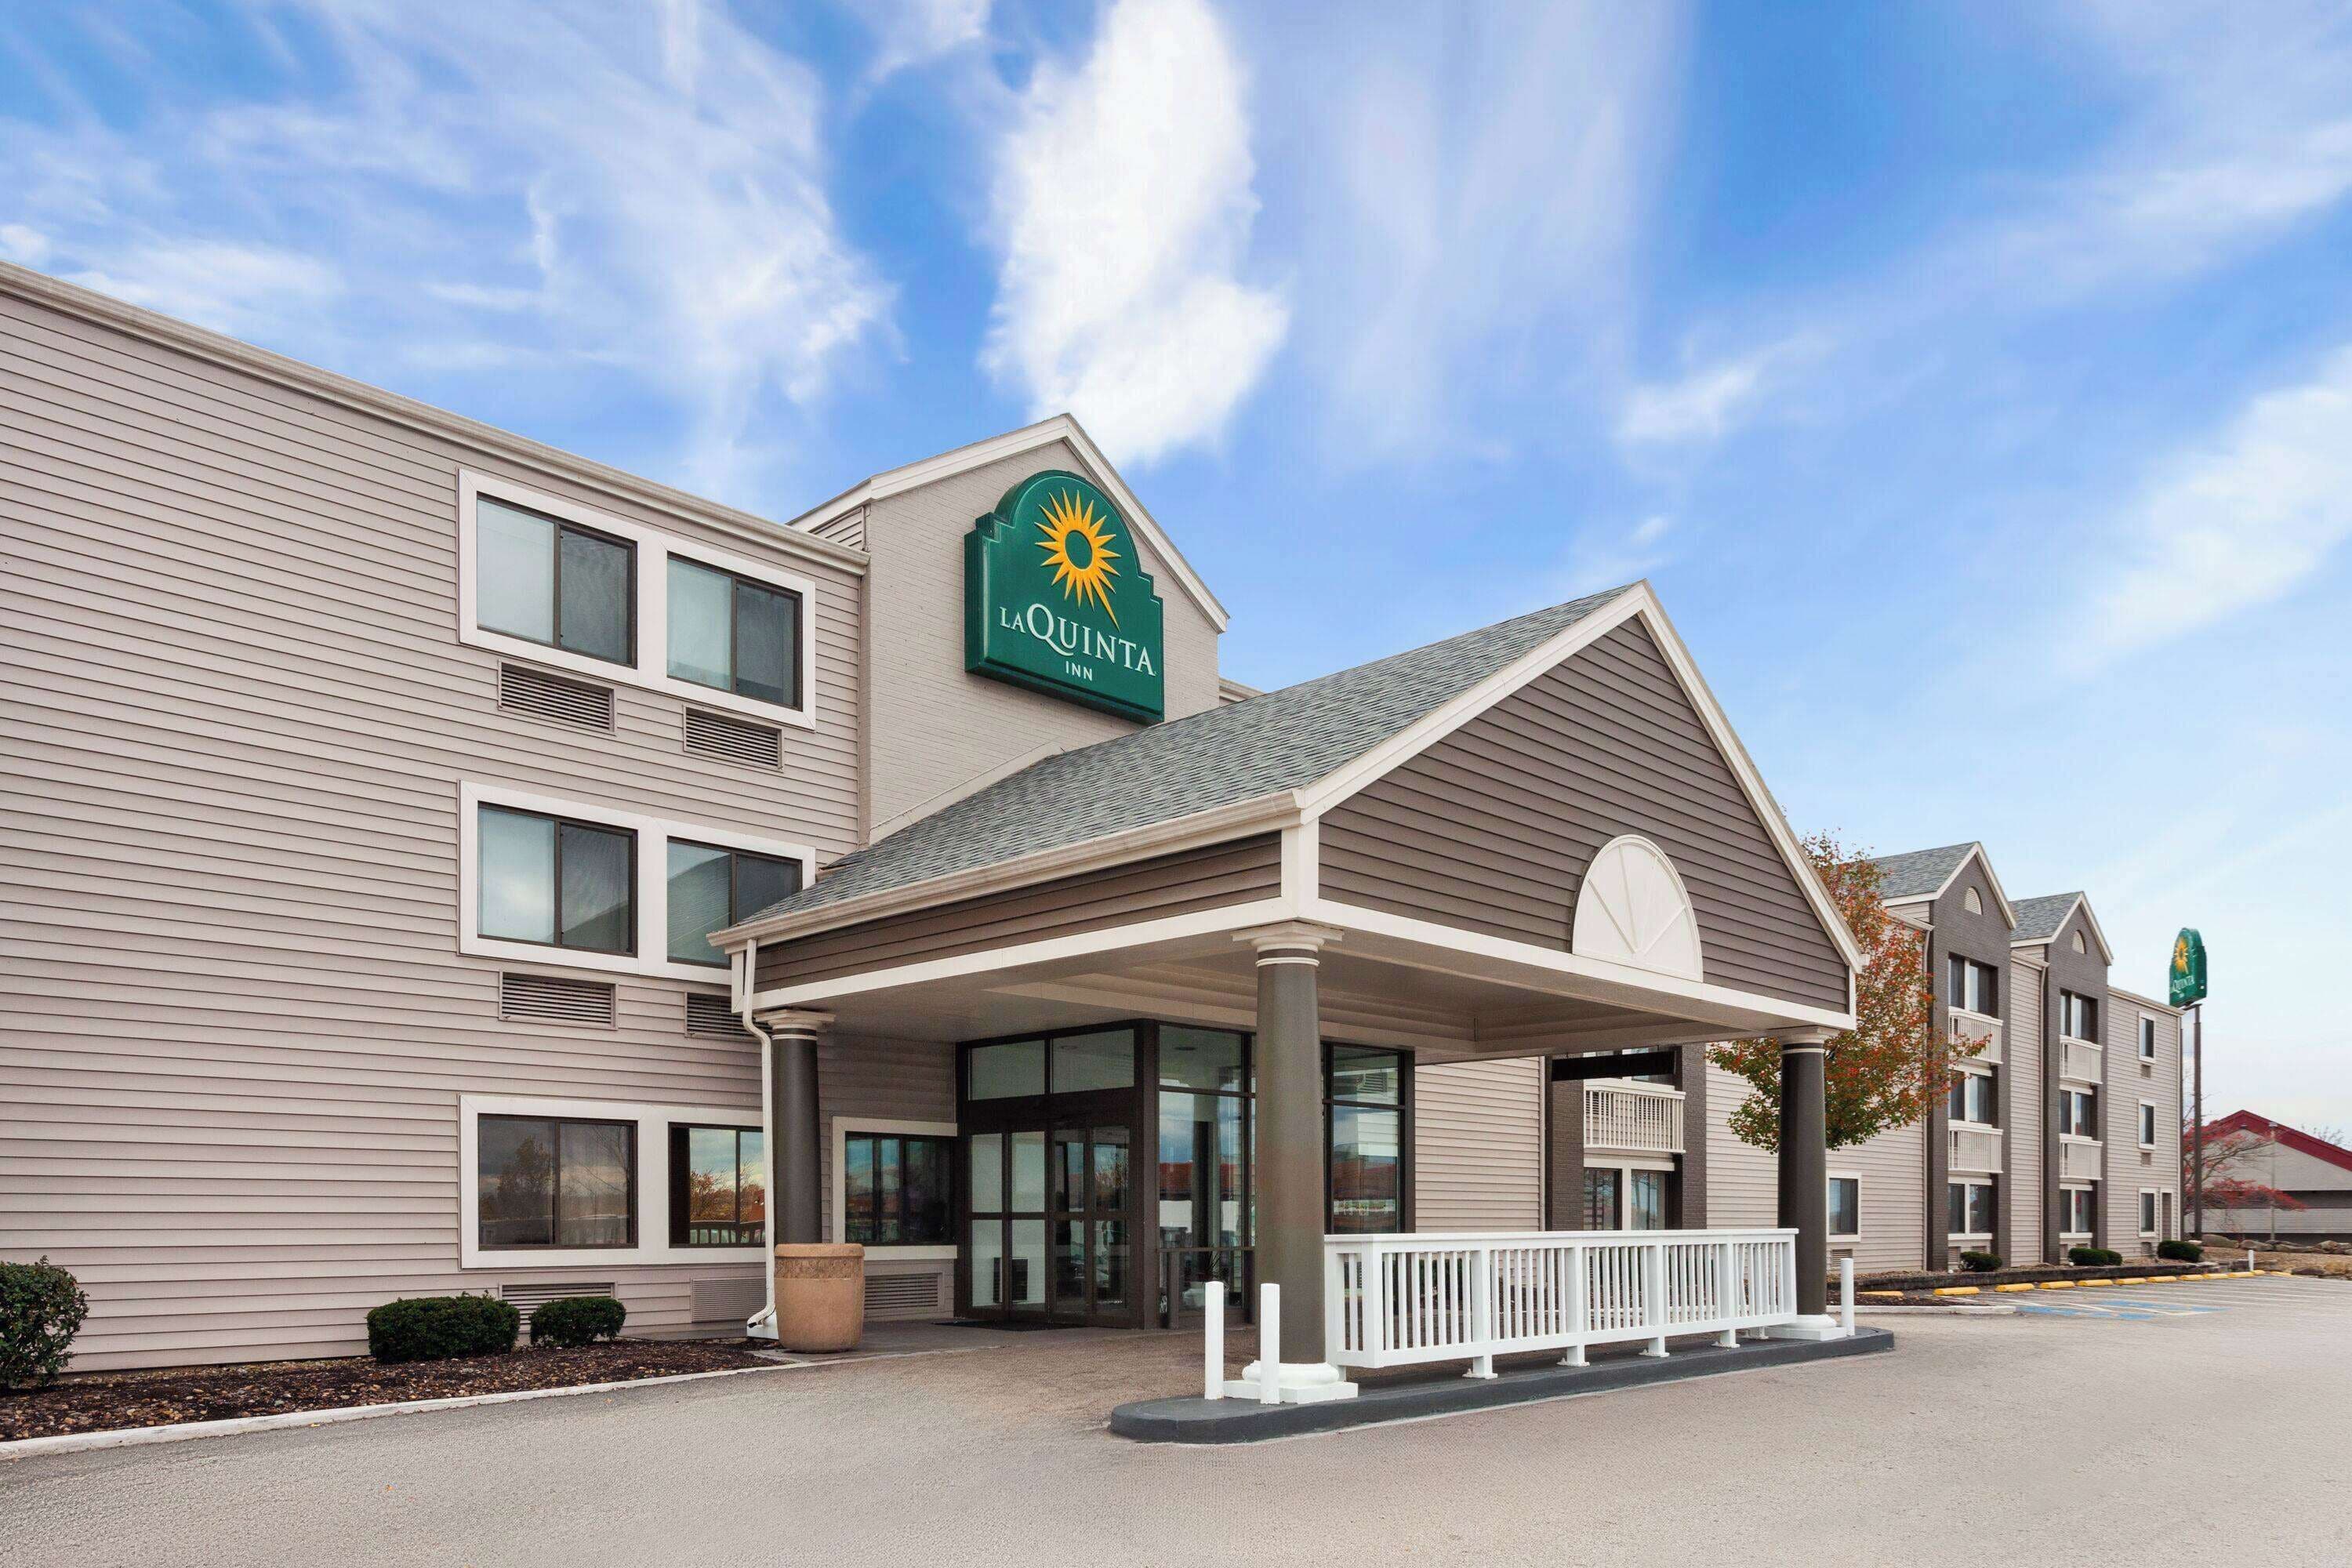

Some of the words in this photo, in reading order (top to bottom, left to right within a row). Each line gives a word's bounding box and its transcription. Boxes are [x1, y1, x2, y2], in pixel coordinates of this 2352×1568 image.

[999, 606, 1026, 633] LA
[1026, 603, 1156, 677] QUINTA
[1065, 660, 1093, 682] INN
